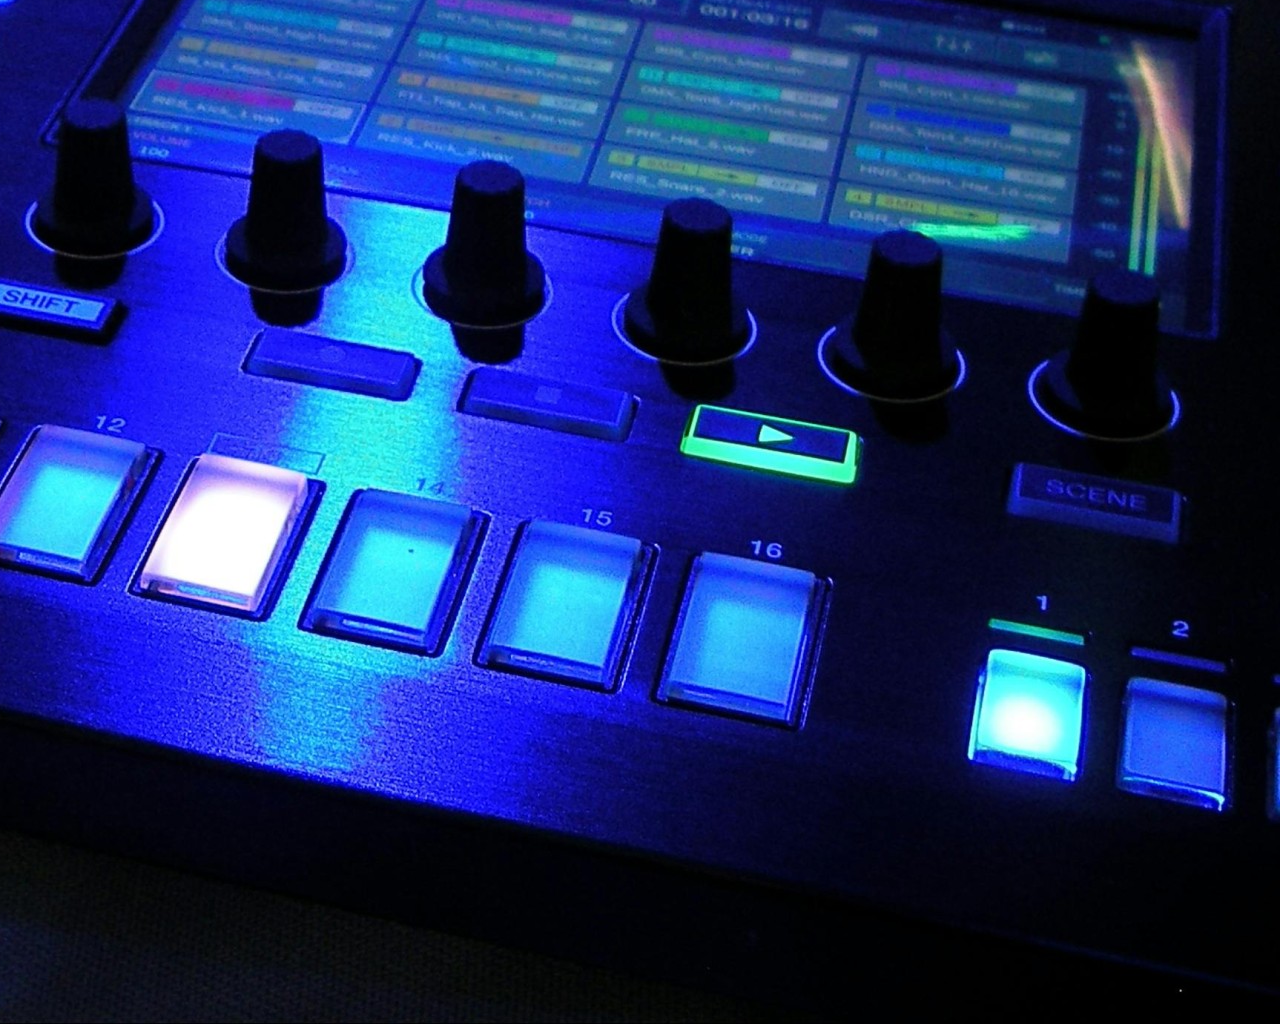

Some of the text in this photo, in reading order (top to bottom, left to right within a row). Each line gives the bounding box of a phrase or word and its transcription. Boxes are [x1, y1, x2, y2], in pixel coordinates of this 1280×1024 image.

[139, 145, 170, 158] 100
[2, 288, 81, 316] SHIFT
[94, 414, 127, 432] 12
[417, 478, 445, 496] 14
[1045, 477, 1148, 512] SCENE
[581, 507, 612, 527] 15
[750, 539, 783, 560] 16
[1035, 594, 1049, 612] 1
[1172, 620, 1190, 637] 2
